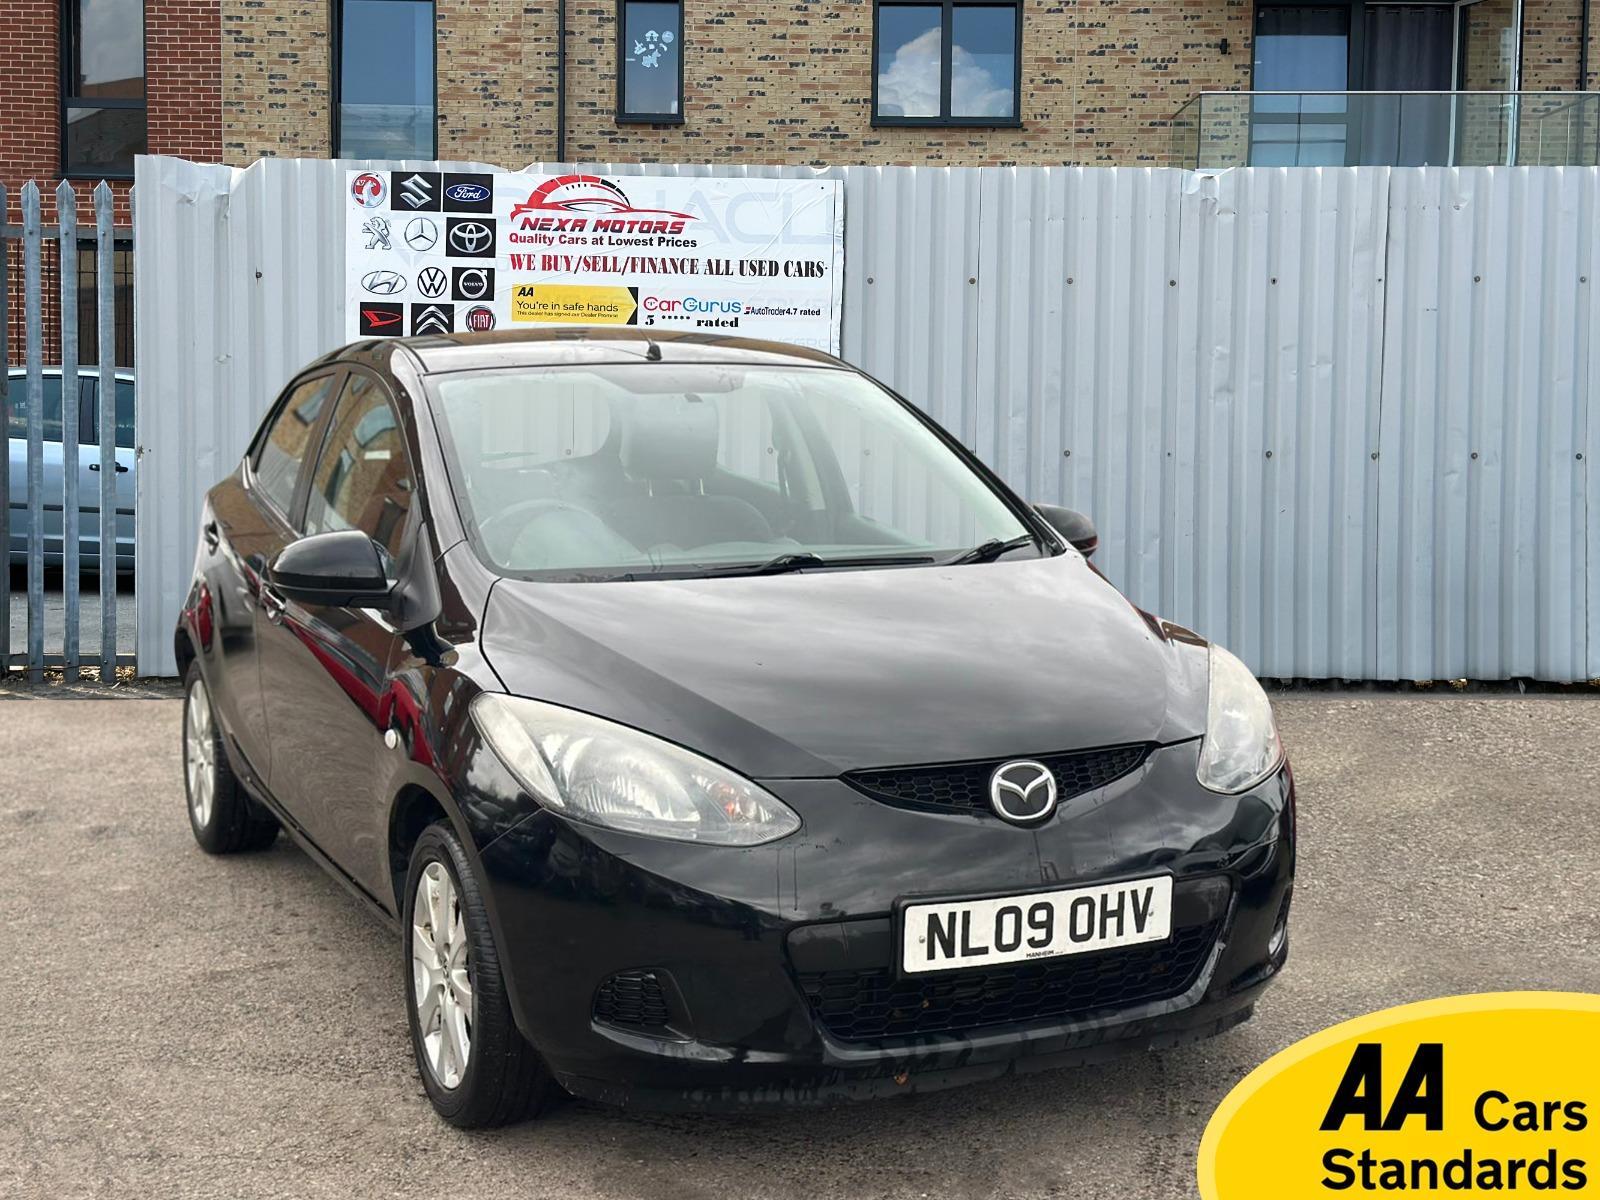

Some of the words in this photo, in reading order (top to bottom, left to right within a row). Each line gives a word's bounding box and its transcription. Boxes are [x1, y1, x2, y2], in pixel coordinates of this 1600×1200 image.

[454, 186, 482, 200] Ford
[520, 217, 588, 232] NEXA
[592, 219, 686, 235] MOTORS
[509, 233, 555, 246] Quality
[558, 235, 588, 245] Cars
[591, 235, 604, 246] at
[608, 236, 654, 247] Lowest
[657, 236, 697, 248] Prices
[509, 253, 536, 271] WE
[704, 258, 734, 276] ALL
[739, 259, 780, 277] USED
[517, 286, 534, 297] AA
[517, 300, 549, 310] You're
[551, 302, 560, 311] in
[563, 302, 585, 311] safe
[587, 302, 619, 312] hands
[643, 296, 742, 313] CarGurus
[800, 308, 821, 316] rated
[473, 314, 490, 328] FIAT
[644, 314, 655, 326] 5
[696, 317, 739, 328] rated
[927, 901, 1054, 961] NL09
[1069, 886, 1154, 943] OHV
